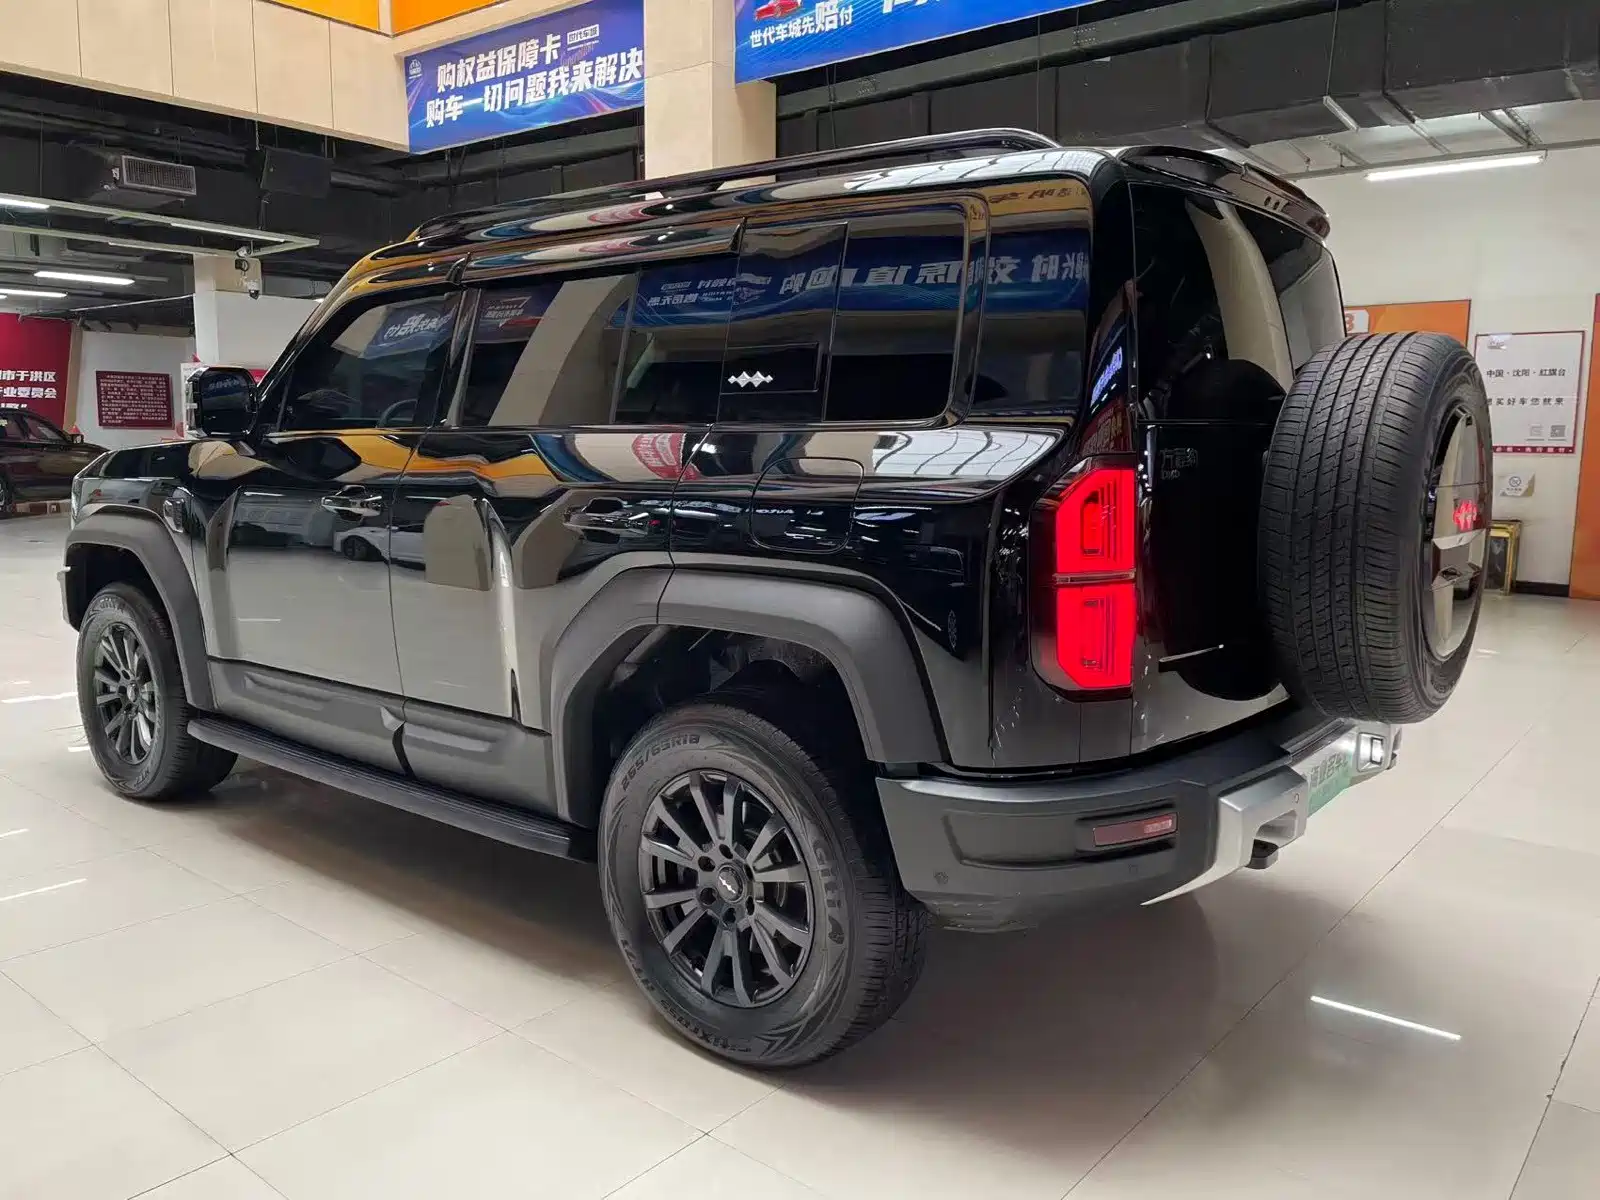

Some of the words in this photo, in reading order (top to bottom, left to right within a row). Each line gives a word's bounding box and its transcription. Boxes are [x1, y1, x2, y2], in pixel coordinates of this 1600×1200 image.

[750, 1, 853, 48] 世代车城先赔付
[437, 34, 562, 93] 购权益保障卡
[426, 47, 643, 128] 购车一切问题我来解决
[0, 369, 56, 382] 市于洪区
[0, 387, 57, 399] 业委员会
